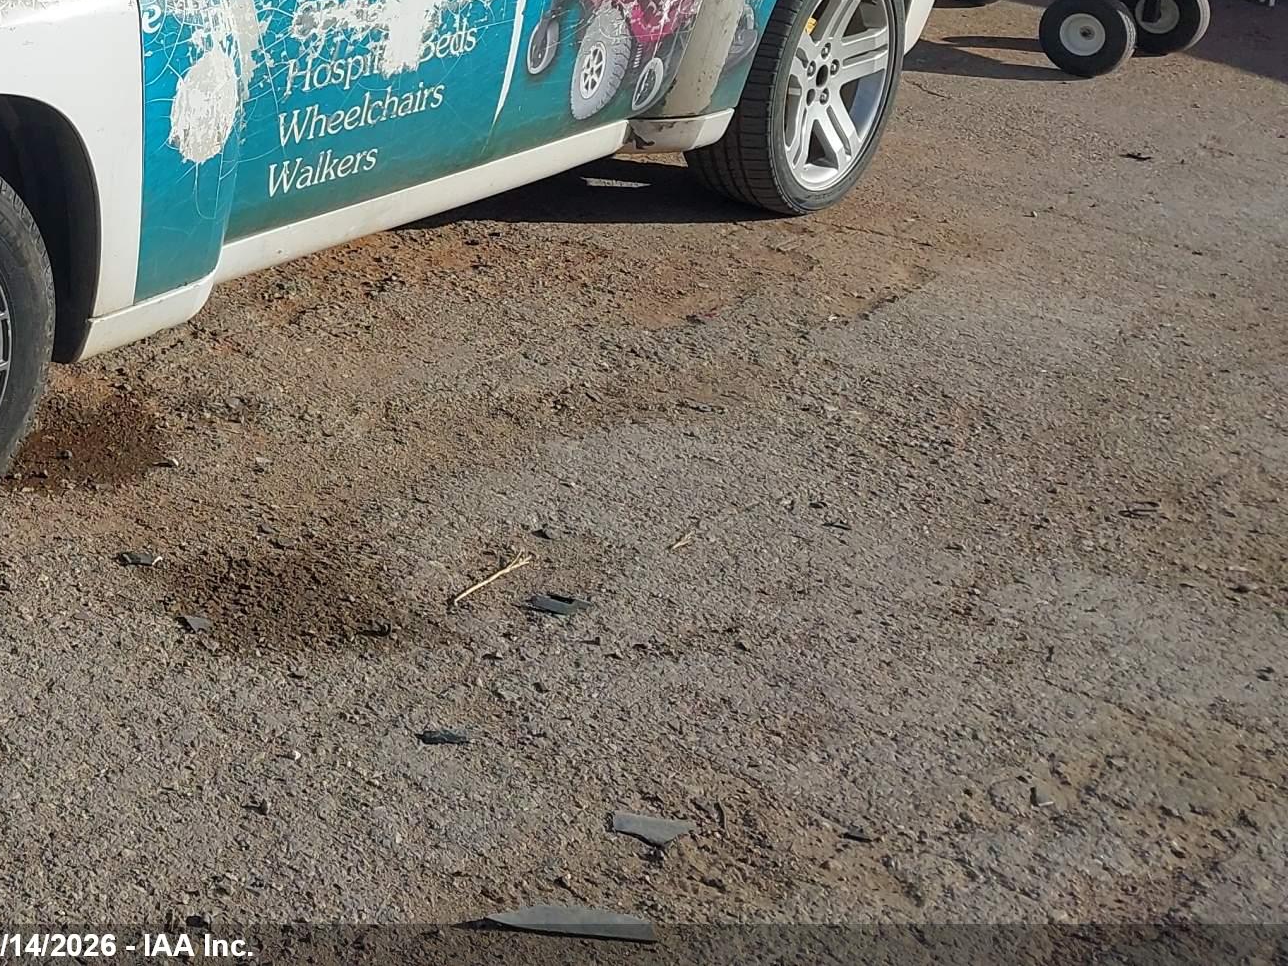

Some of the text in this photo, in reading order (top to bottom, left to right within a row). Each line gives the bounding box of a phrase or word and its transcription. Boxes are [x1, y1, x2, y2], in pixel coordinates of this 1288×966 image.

[283, 48, 394, 94] Hospit
[278, 81, 446, 148] Wheelchairs
[268, 147, 379, 198] Walkers
